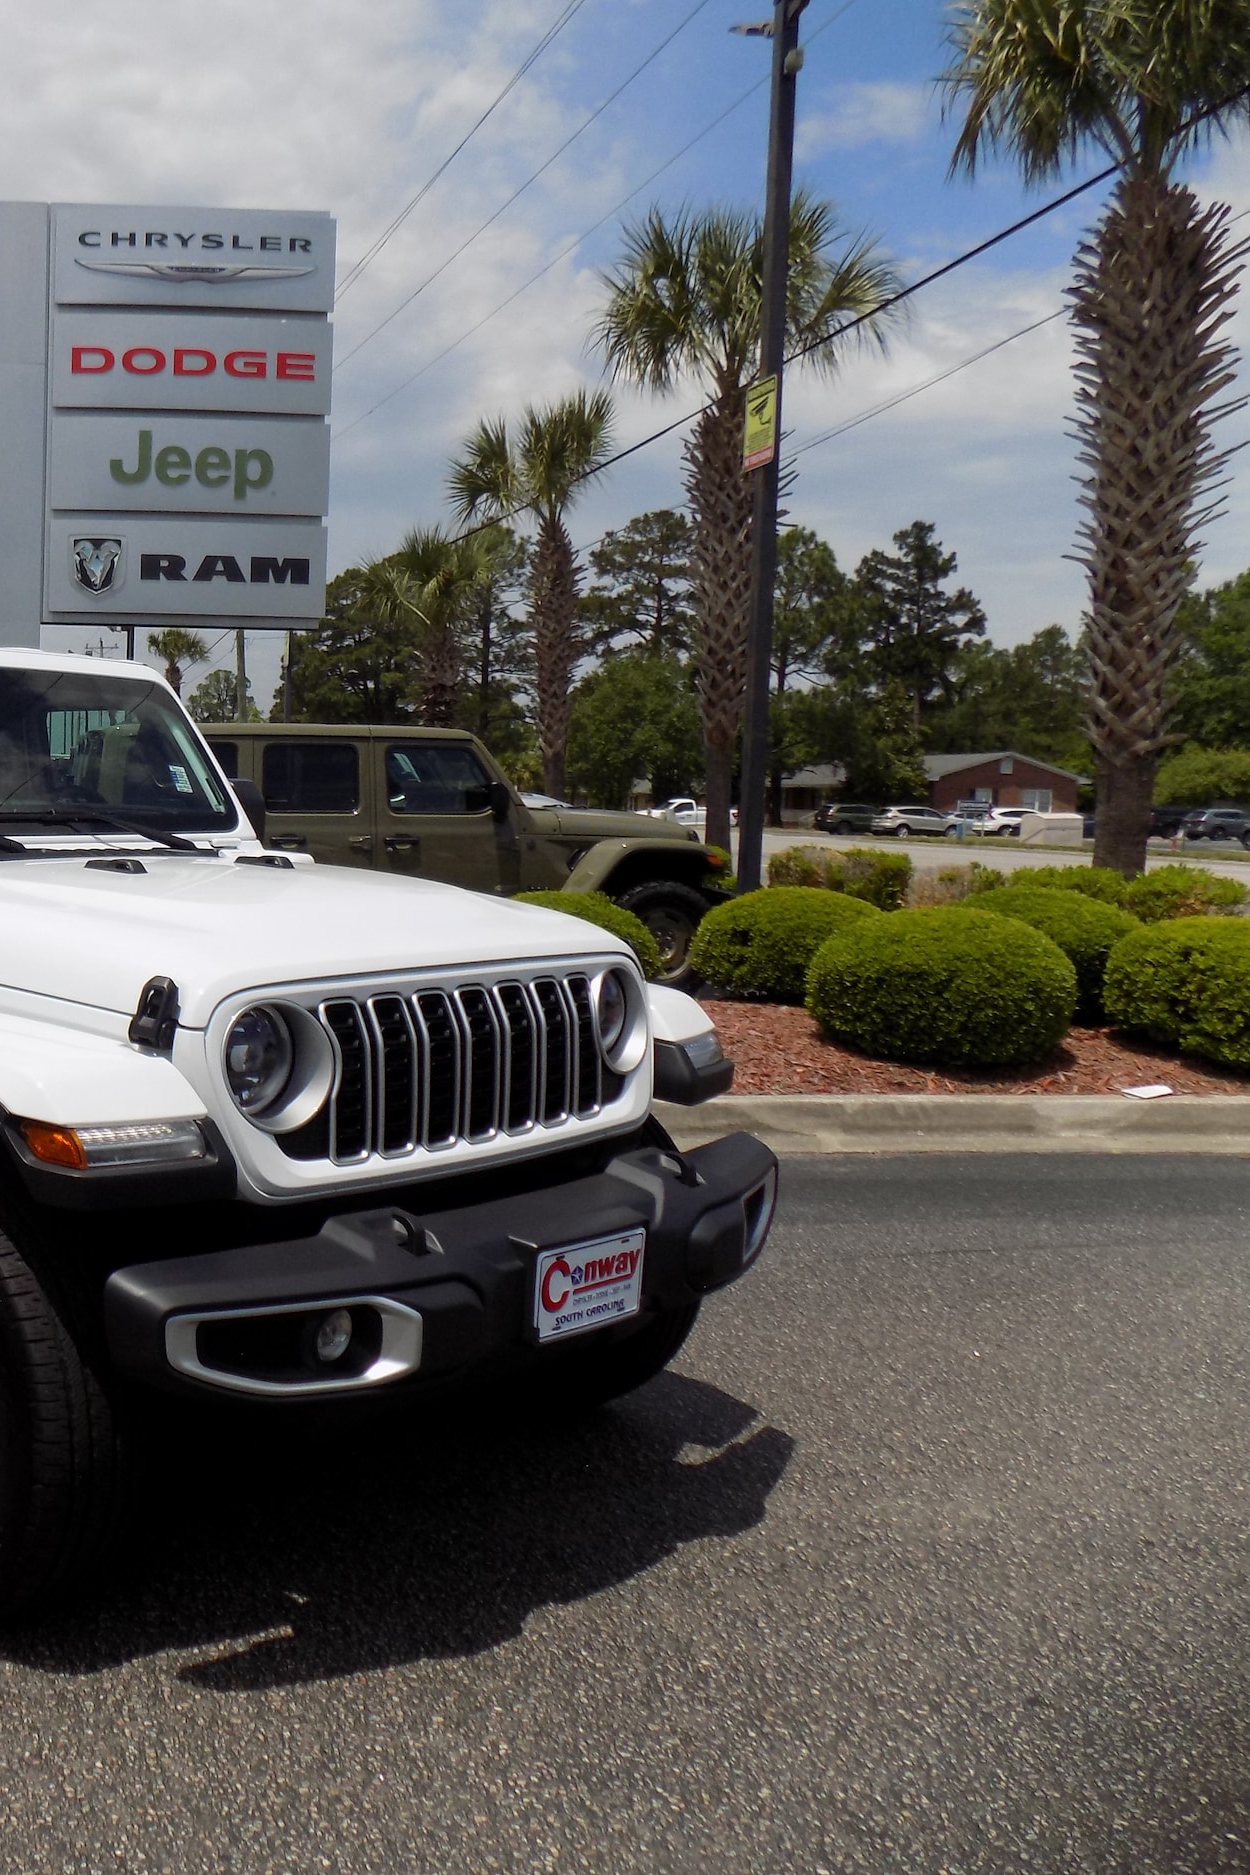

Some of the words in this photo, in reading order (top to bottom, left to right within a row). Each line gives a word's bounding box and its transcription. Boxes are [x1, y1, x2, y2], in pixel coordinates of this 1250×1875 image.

[78, 231, 313, 254] CHRYSLER
[71, 345, 316, 382] DODGE
[110, 430, 274, 500] Jeep
[140, 554, 310, 585] RAM
[554, 1311, 583, 1326] SOUTH
[586, 1298, 625, 1317] CAROLINA
